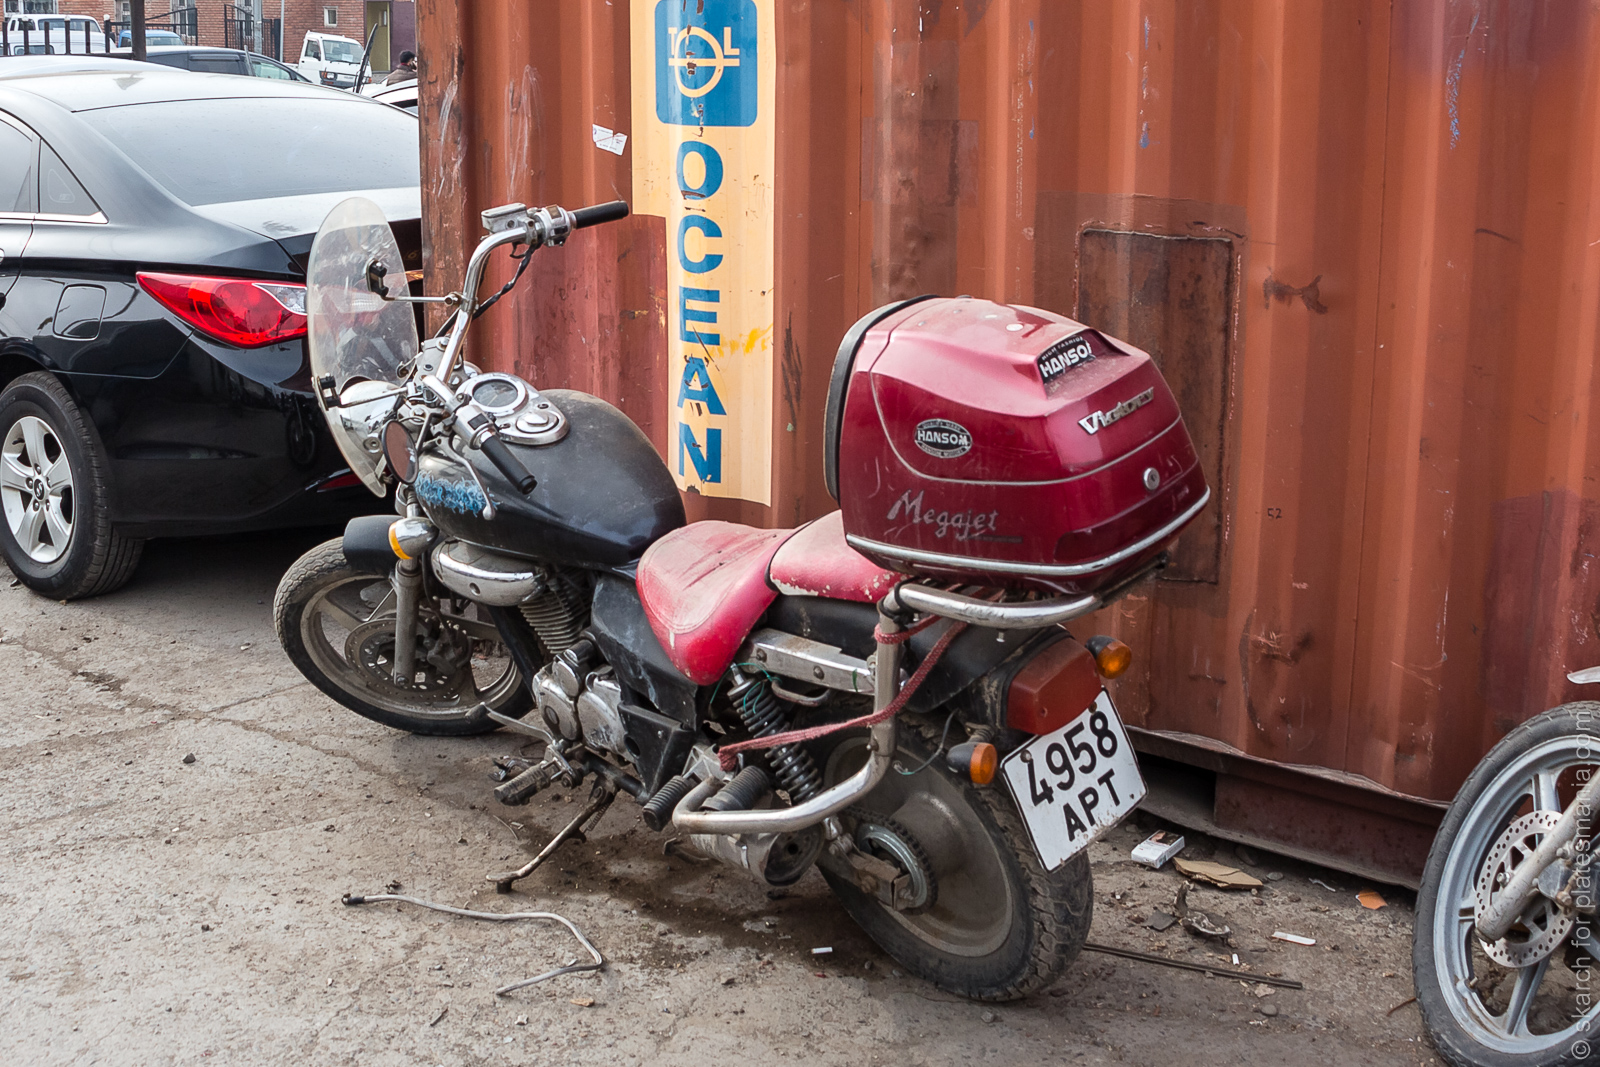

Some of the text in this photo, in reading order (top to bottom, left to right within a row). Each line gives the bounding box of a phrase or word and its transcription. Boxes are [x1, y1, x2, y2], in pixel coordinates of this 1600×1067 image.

[676, 140, 727, 484] OCEAN
[917, 430, 968, 446] HANSOM
[886, 489, 999, 541] Megajet
[1267, 508, 1282, 519] 52
[1027, 710, 1118, 806] 4958
